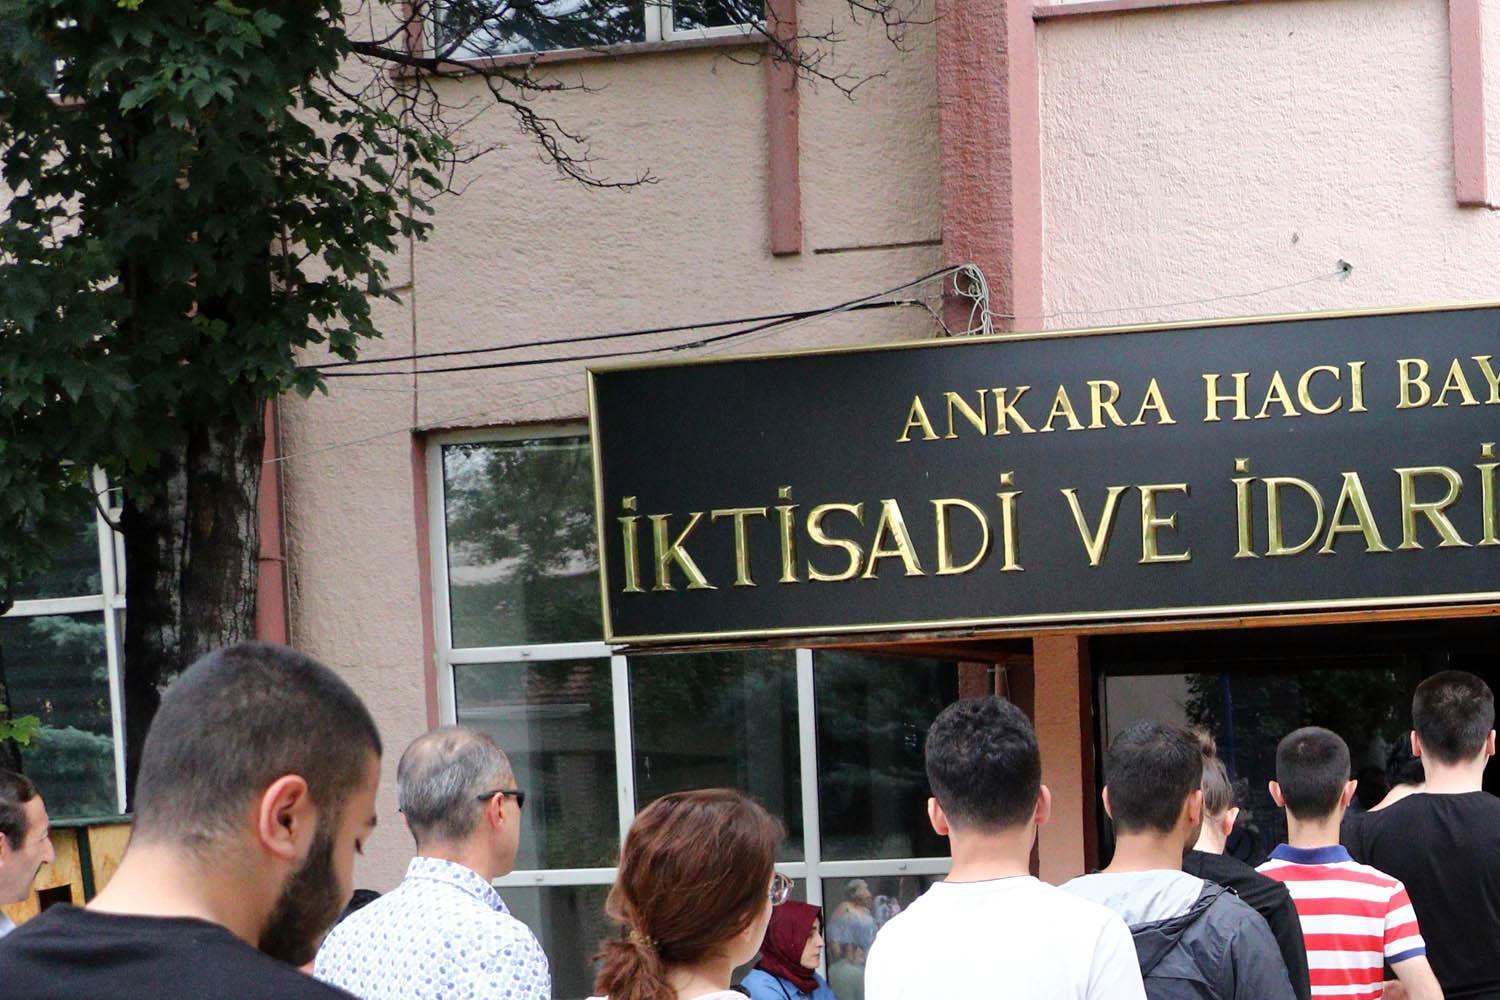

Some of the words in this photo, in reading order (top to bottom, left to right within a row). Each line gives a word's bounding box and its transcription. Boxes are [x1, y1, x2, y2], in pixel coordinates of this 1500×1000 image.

[895, 376, 1178, 443] ANKARA
[1202, 360, 1366, 423] HACI
[616, 470, 1025, 593] İKTİSADİ
[1060, 483, 1192, 566] VE
